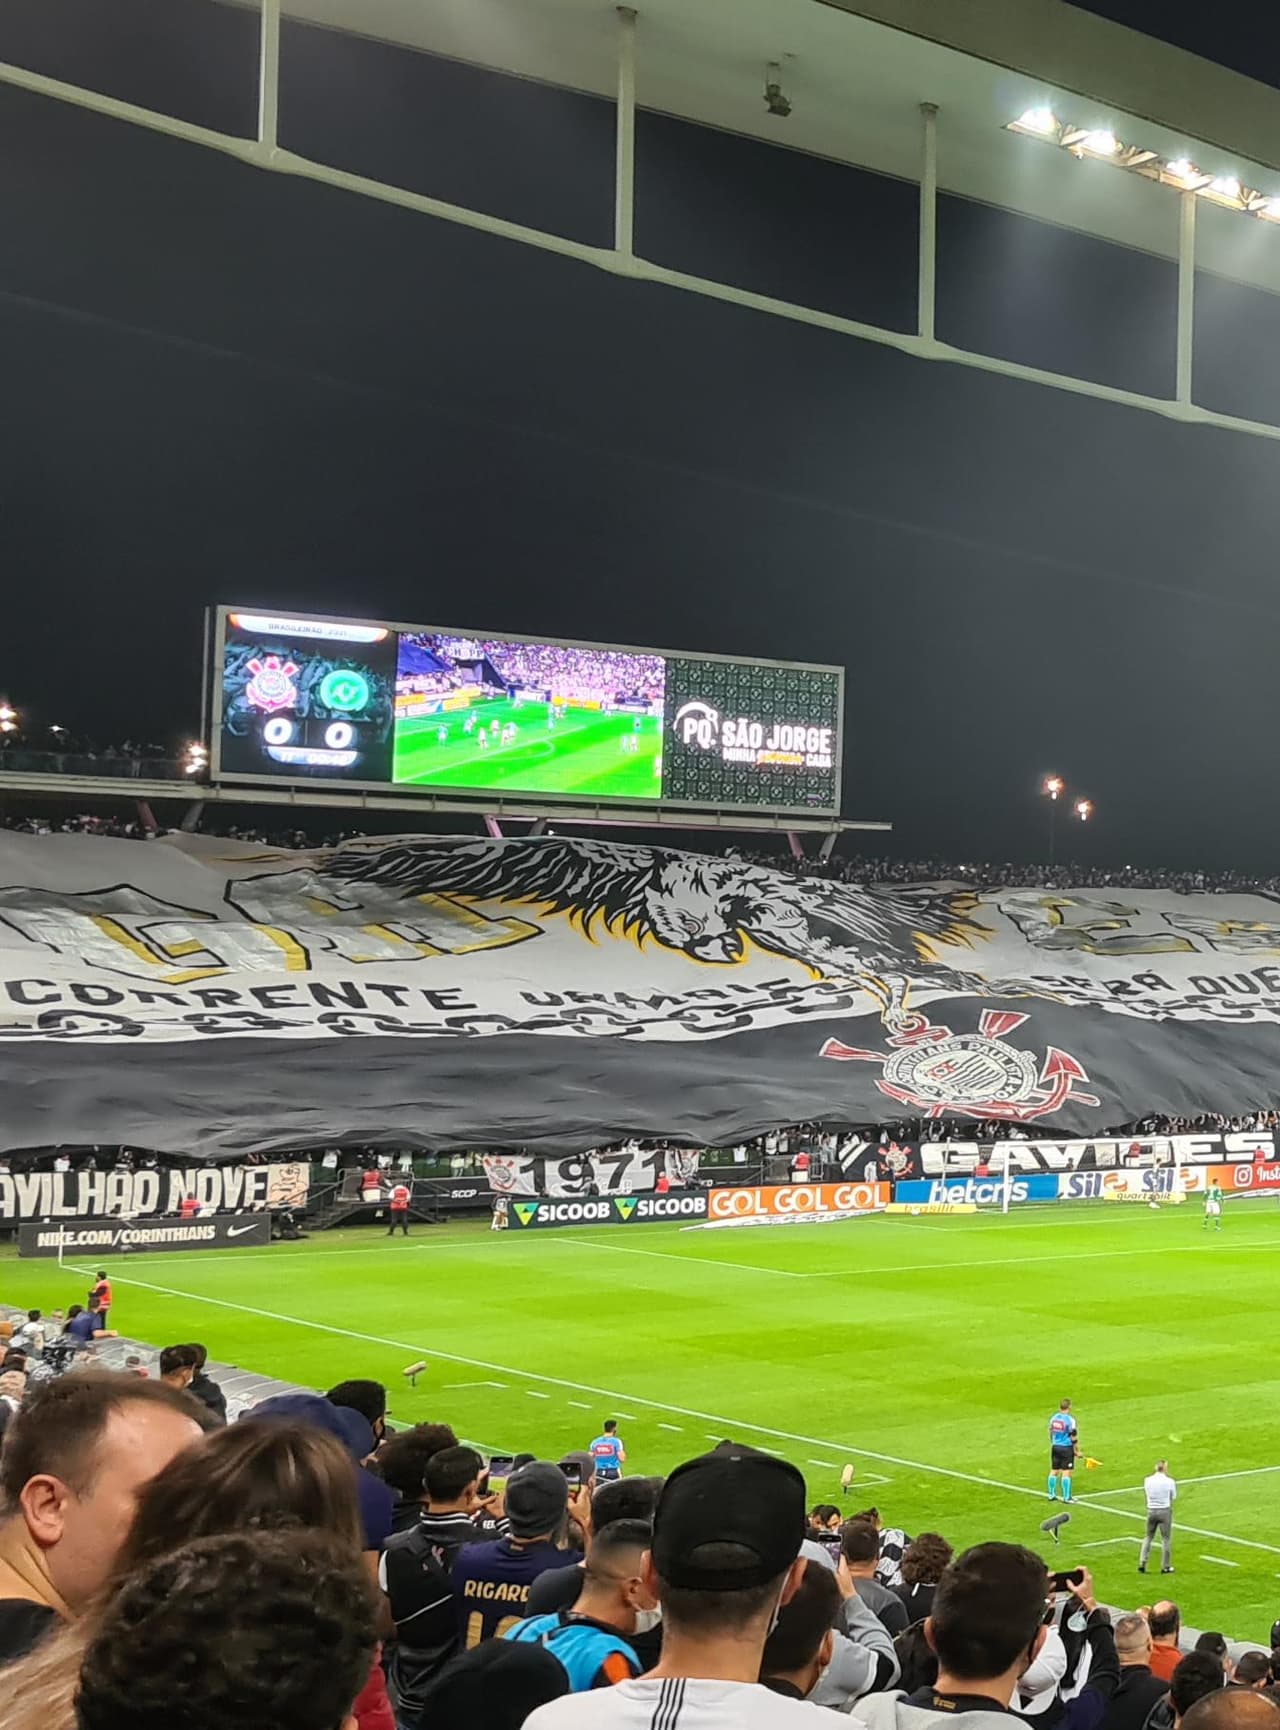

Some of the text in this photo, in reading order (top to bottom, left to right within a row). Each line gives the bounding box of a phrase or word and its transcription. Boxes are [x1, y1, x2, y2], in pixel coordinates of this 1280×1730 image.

[264, 717, 352, 749] 0 0
[722, 717, 763, 748] SÃO
[766, 725, 832, 753] JORGE
[519, 1150, 666, 1196] 1971
[1068, 1172, 1101, 1198] Sil
[168, 1166, 268, 1214] NOVE
[451, 1188, 478, 1199] SCCP
[712, 1184, 890, 1214] GOL GOL GOL
[537, 1202, 610, 1222] SICOOB
[637, 1197, 706, 1217] SICOOB
[37, 1225, 216, 1247] NIKE.COM/CORINTHIANS
[466, 1611, 524, 1650] 1
